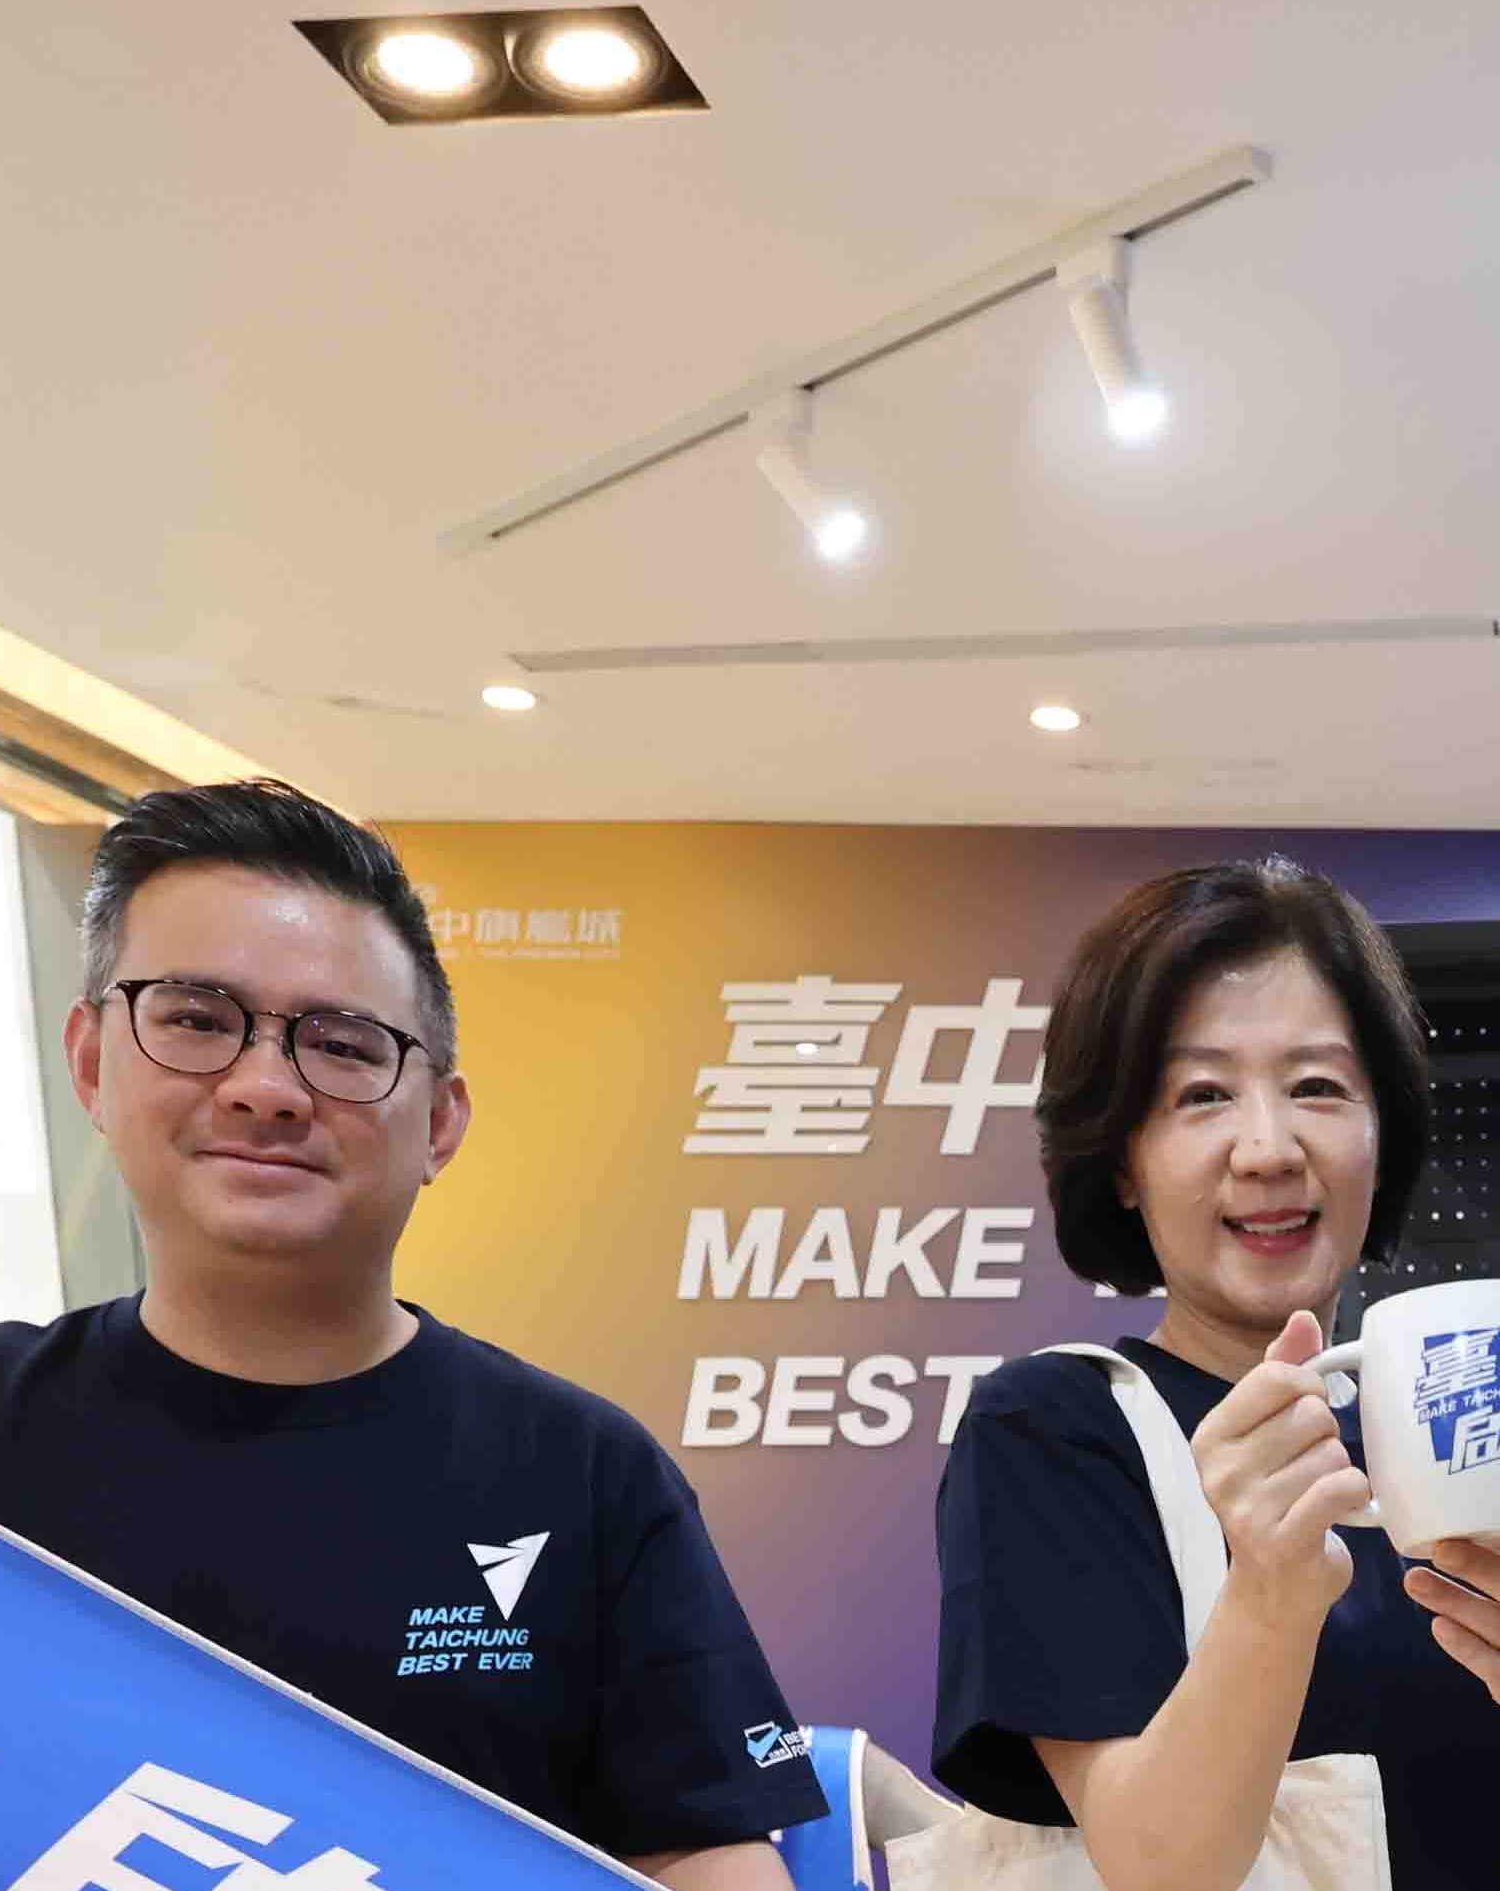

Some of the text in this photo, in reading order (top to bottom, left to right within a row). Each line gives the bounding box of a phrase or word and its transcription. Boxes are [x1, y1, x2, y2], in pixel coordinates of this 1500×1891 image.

[683, 975, 1053, 1156] 臺中
[676, 1207, 1035, 1299] MAKE
[680, 1355, 1003, 1448] BEST
[405, 1629, 529, 1650] TAICHUNG
[408, 1606, 485, 1626] MAKE
[397, 1652, 534, 1676] BEST EVER
